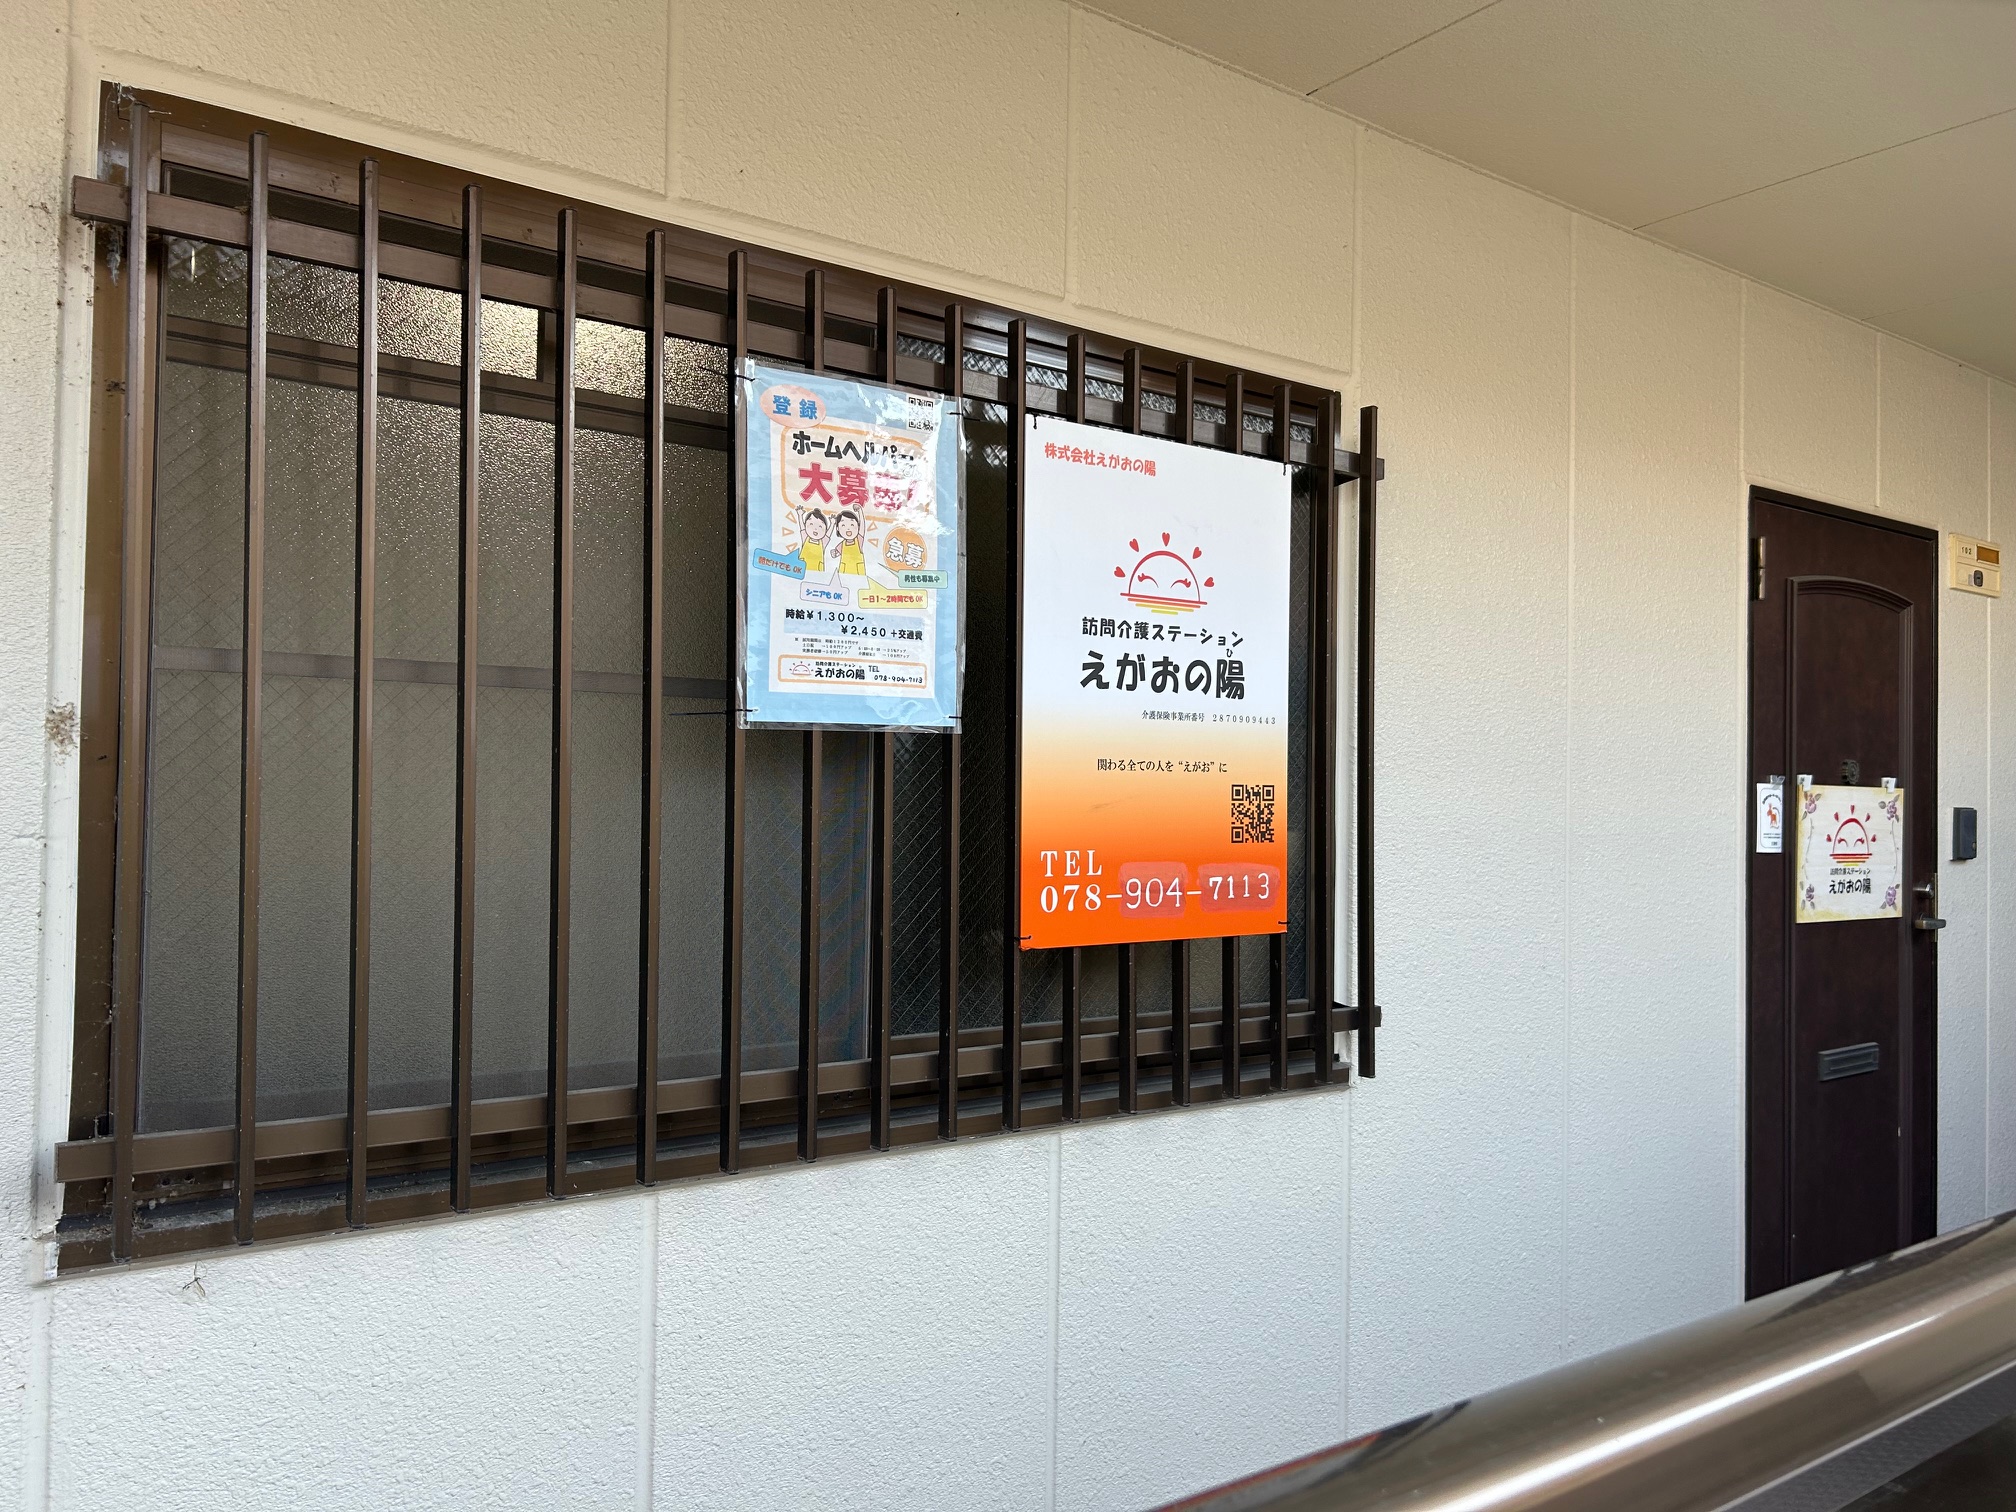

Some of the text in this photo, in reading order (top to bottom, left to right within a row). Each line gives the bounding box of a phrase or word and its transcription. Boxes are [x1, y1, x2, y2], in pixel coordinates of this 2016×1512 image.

[773, 395, 817, 420] 登録
[1044, 442, 1156, 476] 株式会社えがおの陽
[886, 537, 925, 568] 急募
[1961, 547, 1972, 555] 102
[793, 566, 802, 574] OK
[806, 588, 843, 600] シニアも OK
[1082, 616, 1243, 648] 訪問介護ステーション
[1226, 648, 1233, 658] ひ
[814, 667, 866, 680] えがおの陽
[868, 665, 880, 673] TEL
[1079, 650, 1245, 700] えがおの陽
[1141, 710, 1276, 725] 介護保険事業所番号 2870909443
[1040, 850, 1102, 877] TEL
[1040, 872, 1270, 913] 078-904-7113
[1828, 878, 1872, 894] えがおの陽
